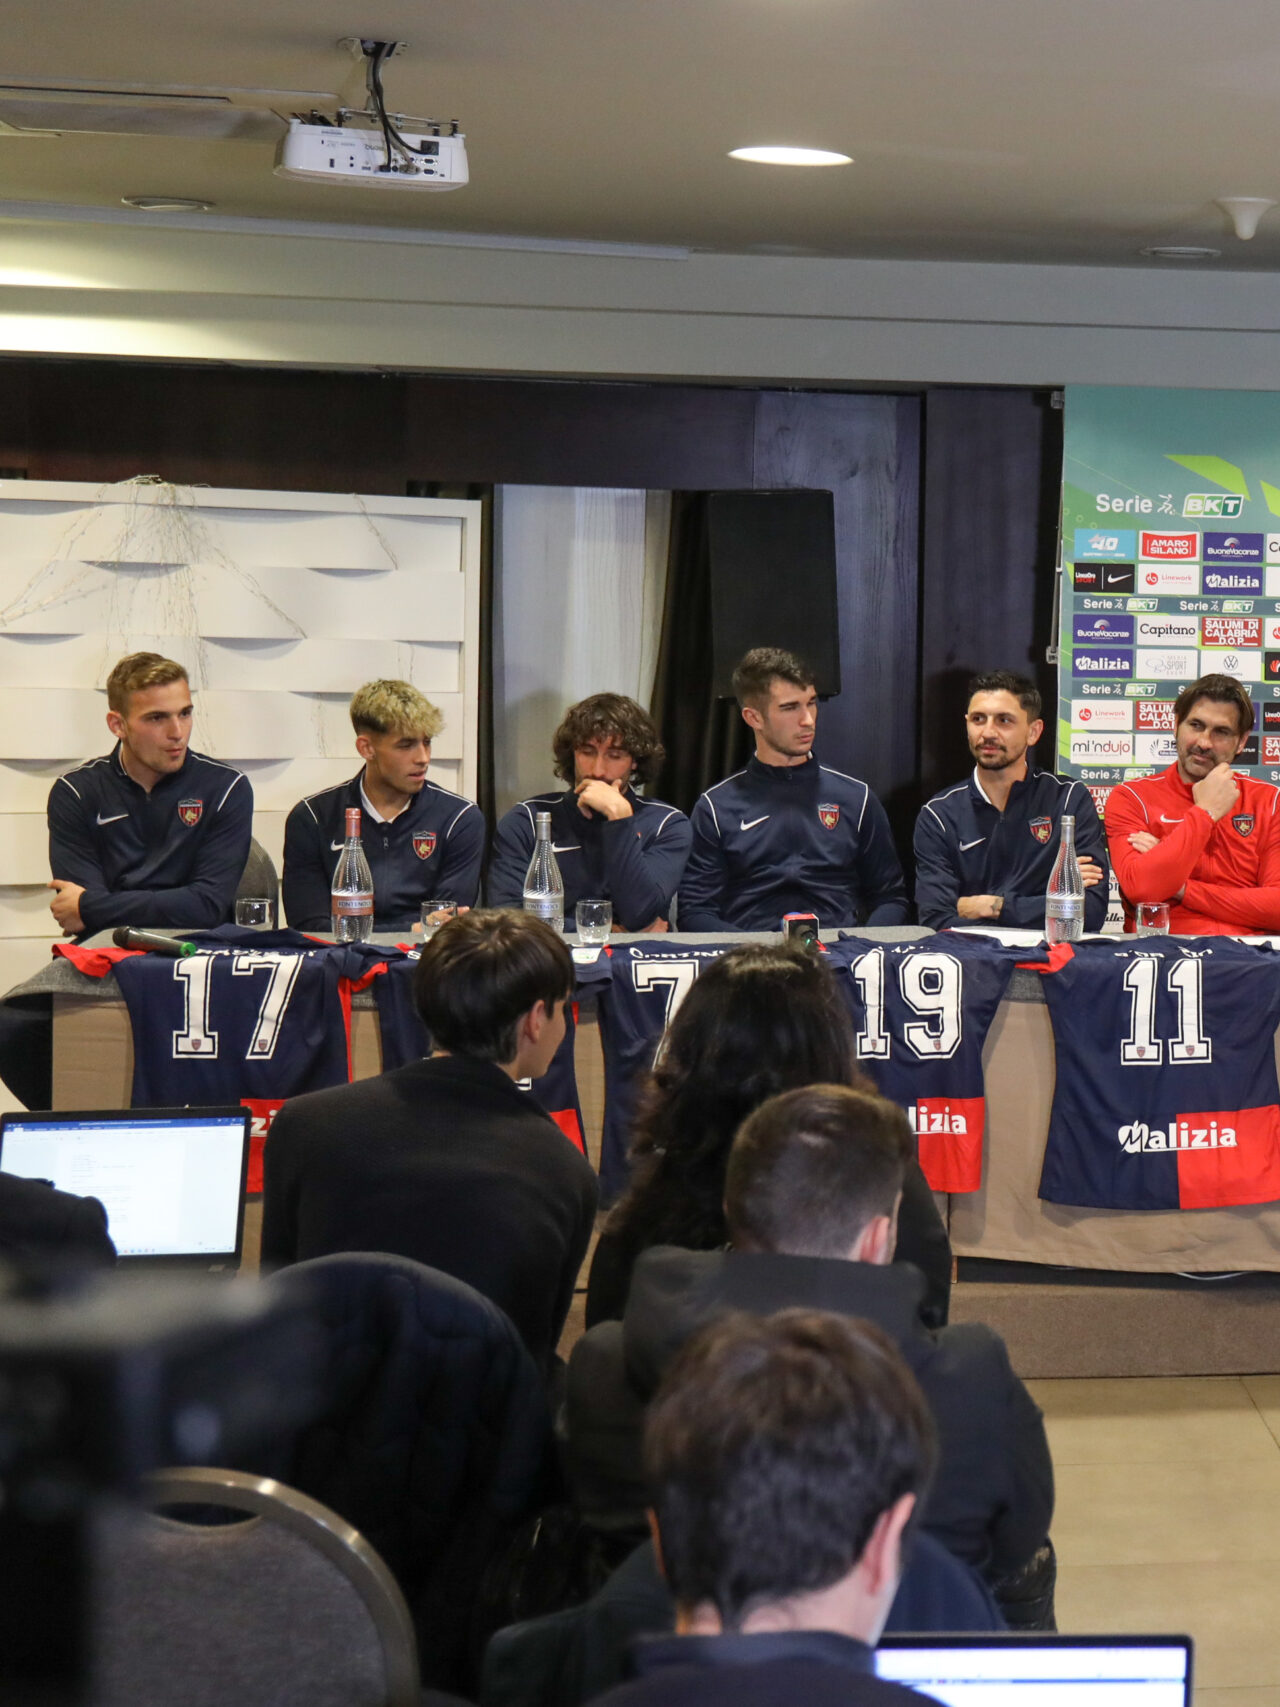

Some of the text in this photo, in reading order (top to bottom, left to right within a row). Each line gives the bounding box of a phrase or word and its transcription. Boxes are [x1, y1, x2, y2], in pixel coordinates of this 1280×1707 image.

[1096, 494, 1241, 514] Serie BKT
[1150, 547, 1189, 555] SILANO
[1206, 574, 1259, 588] Malizia
[1084, 599, 1112, 609] Serie
[1180, 601, 1208, 610] Serie
[1205, 620, 1258, 629] SALUMI DI
[1140, 624, 1195, 637] Capitano
[1205, 629, 1257, 637] CALABRIA
[1075, 656, 1130, 670] Malizia
[1082, 685, 1111, 694] Serie
[1139, 704, 1174, 712] SALUM
[1139, 713, 1175, 721] CALAB
[1081, 770, 1109, 779] Serie
[173, 954, 304, 1060] 17
[851, 948, 962, 1060] 19
[1121, 957, 1212, 1065] 11
[907, 1105, 967, 1135] lizia
[1118, 1120, 1237, 1153] Malizia
